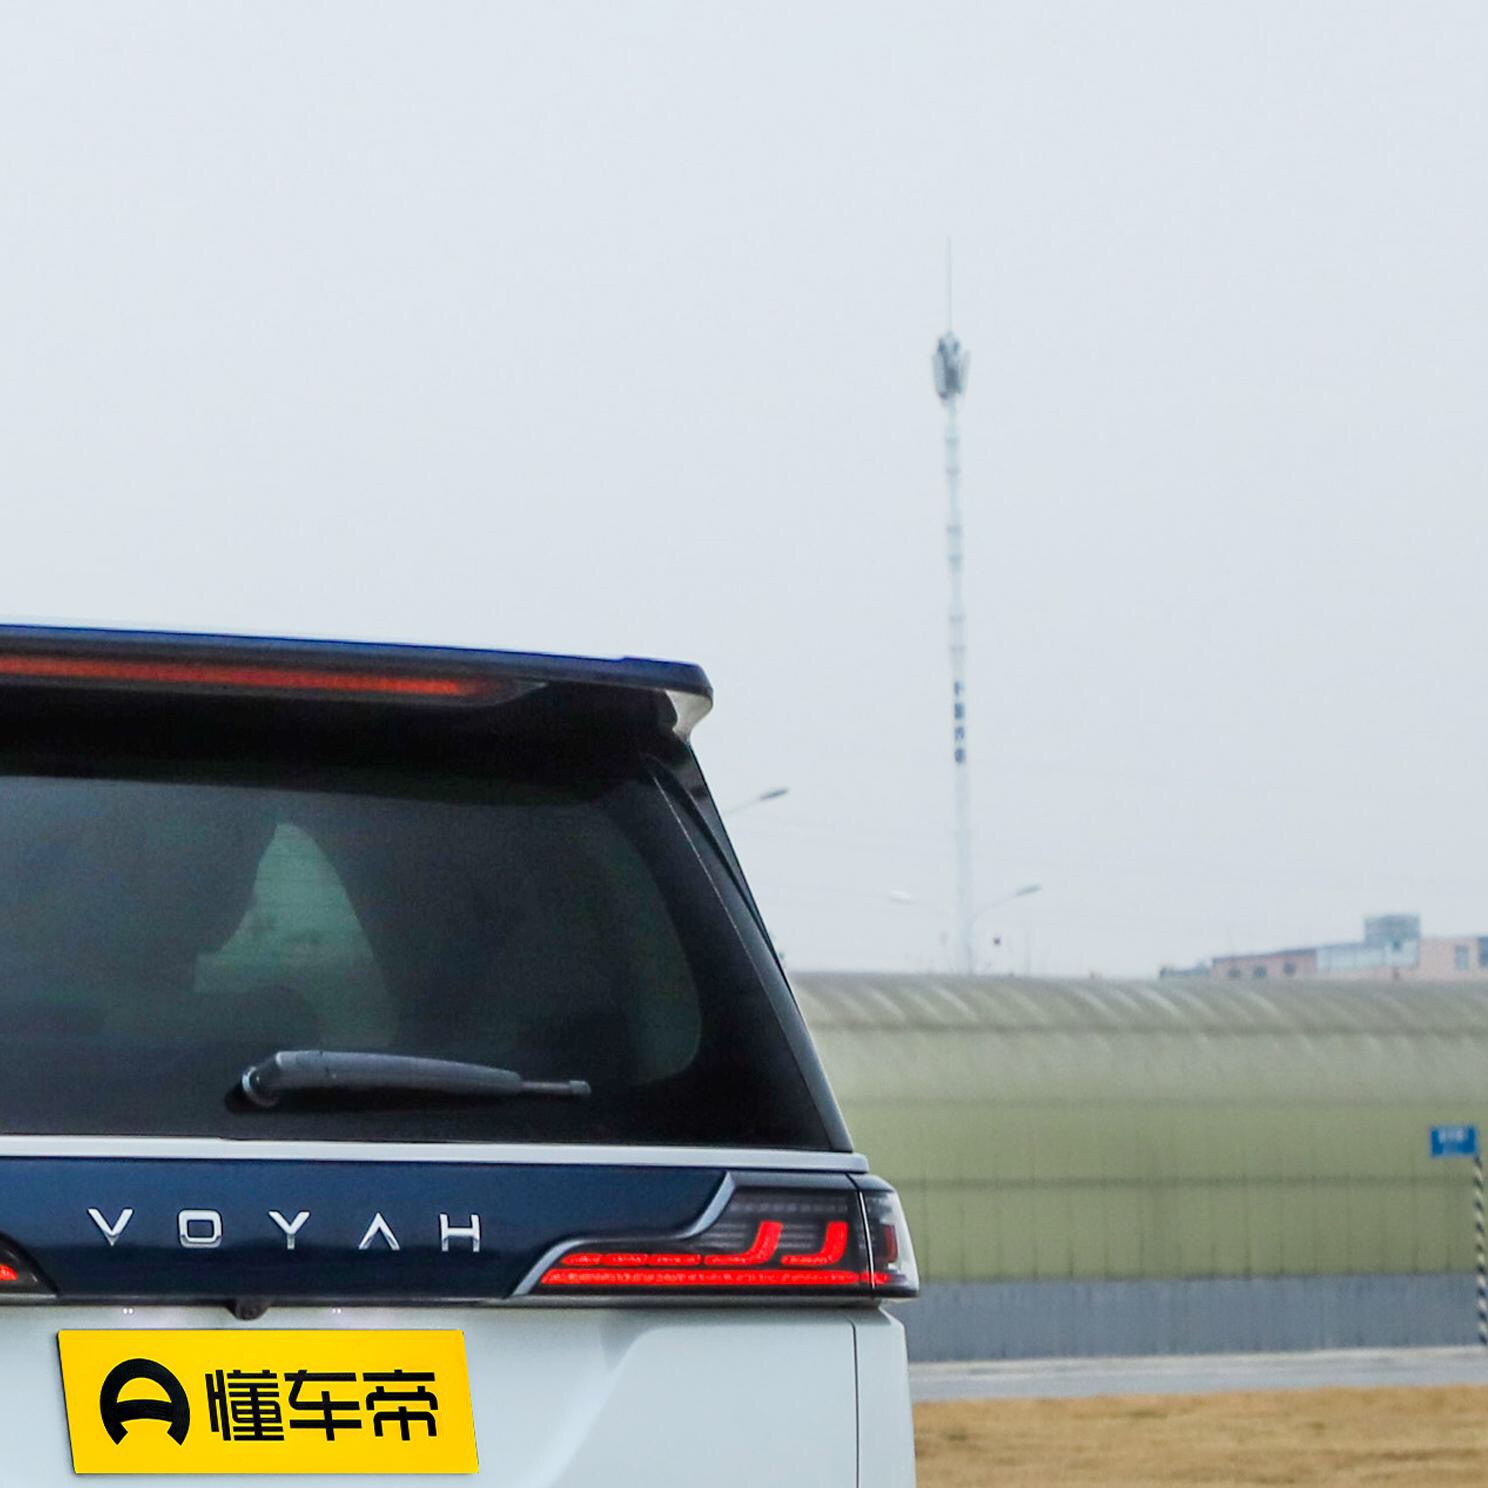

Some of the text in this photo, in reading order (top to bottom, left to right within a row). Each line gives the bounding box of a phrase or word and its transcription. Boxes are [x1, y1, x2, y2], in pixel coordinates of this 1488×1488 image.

[88, 1208, 481, 1252] VOYAH
[205, 1368, 439, 1441] 懂车帝
